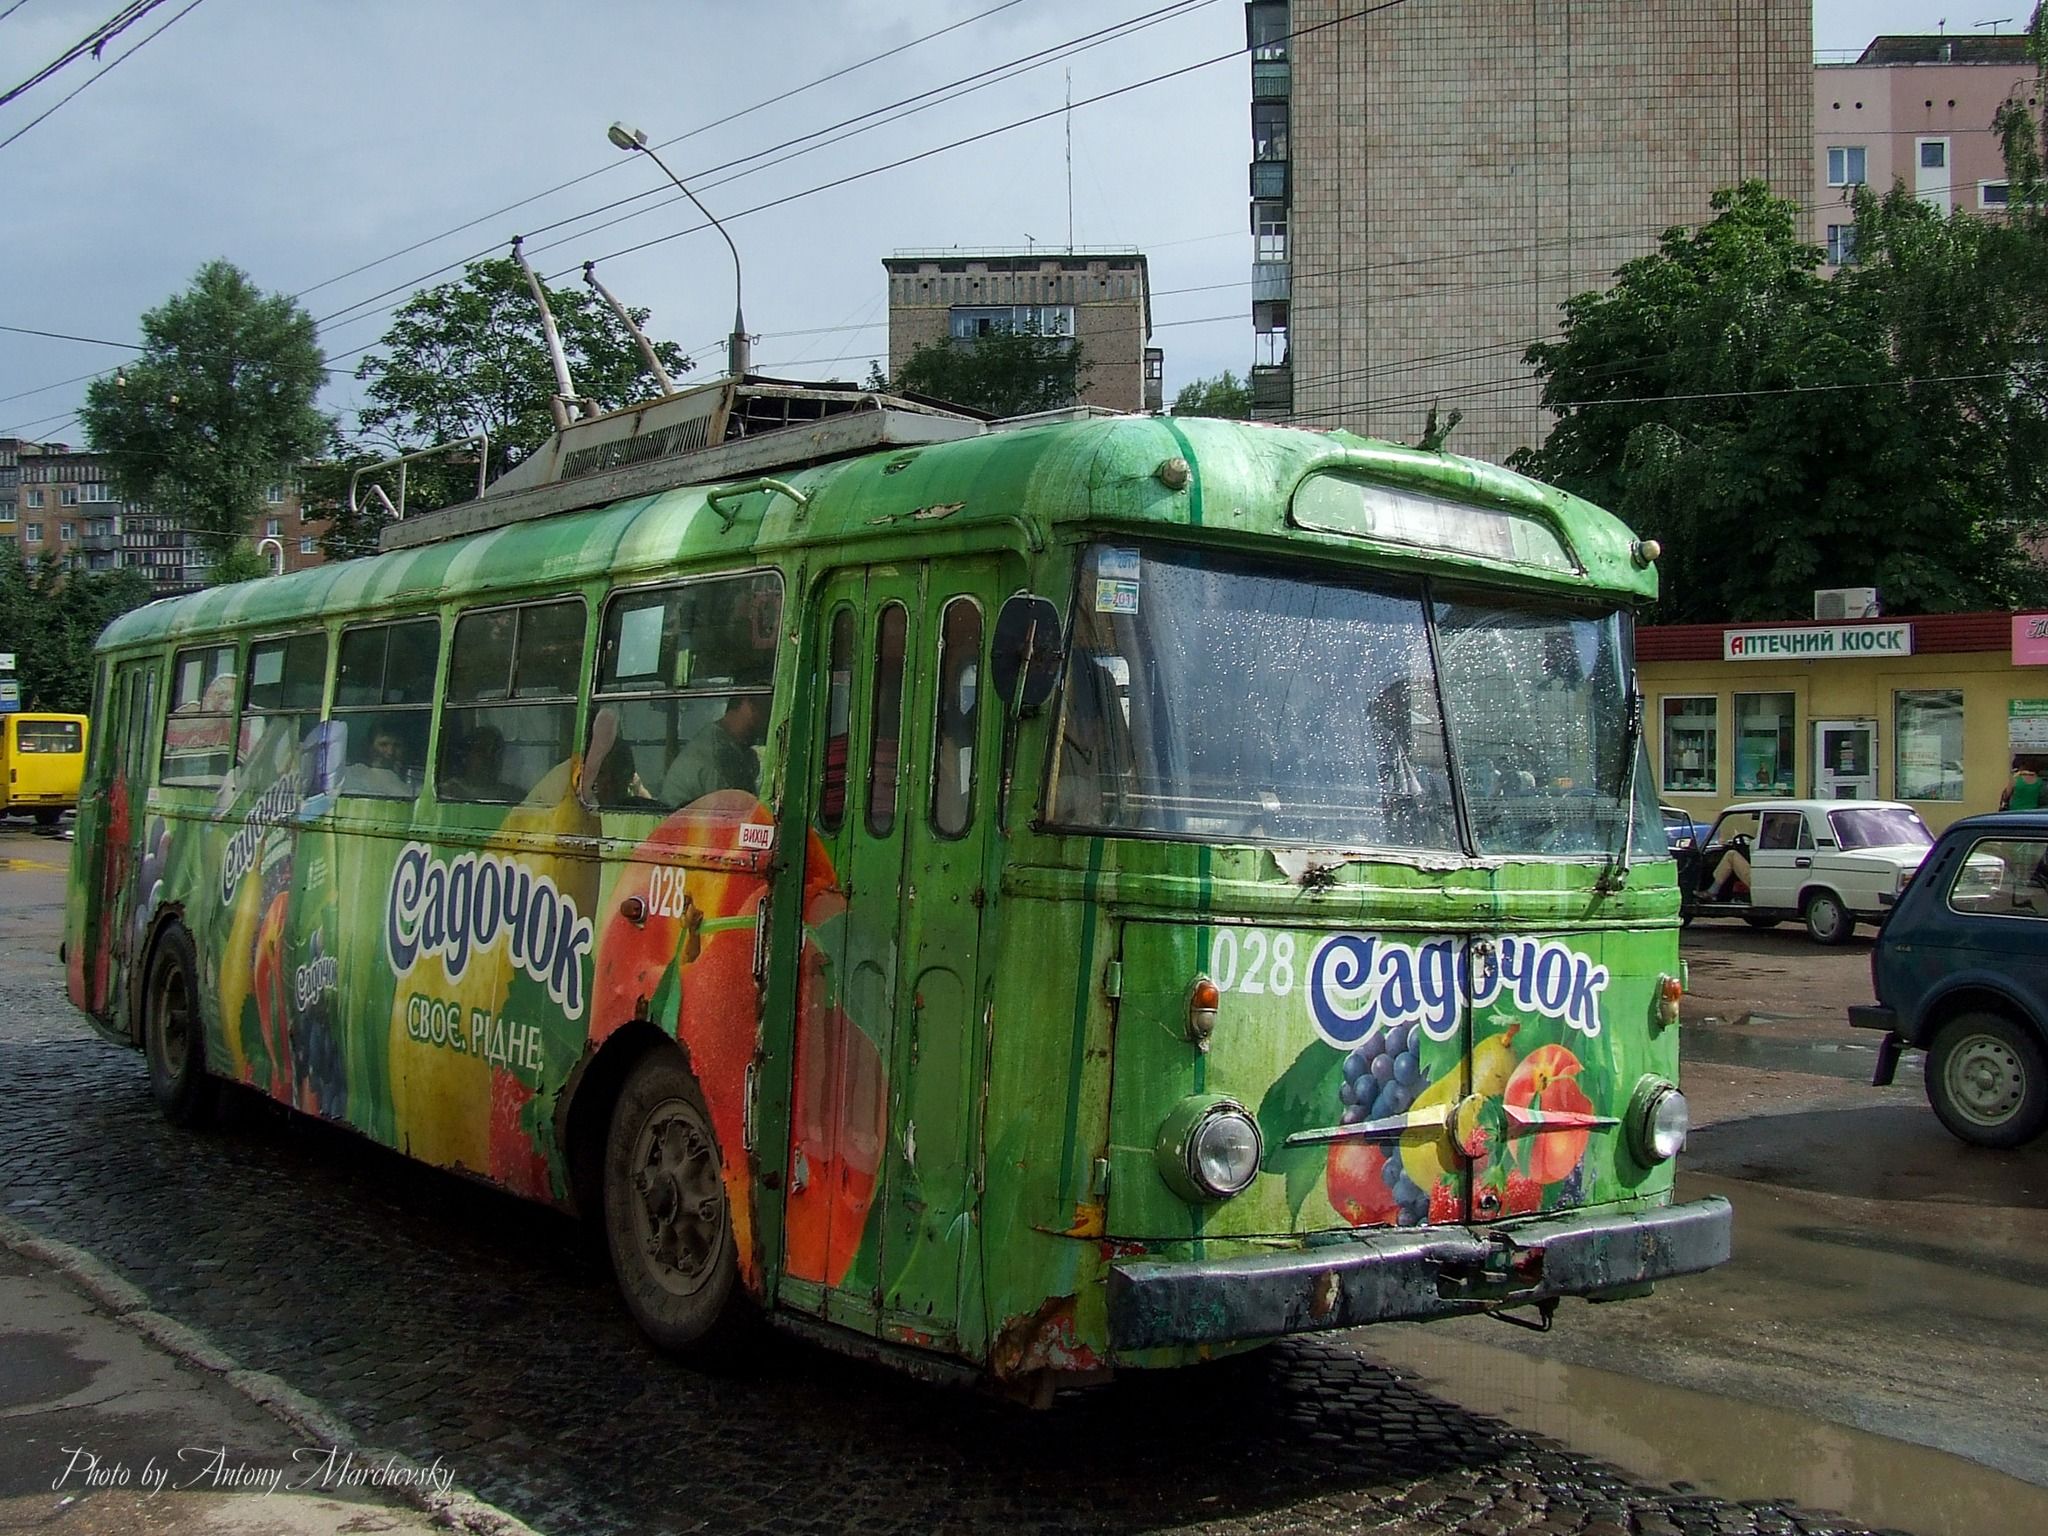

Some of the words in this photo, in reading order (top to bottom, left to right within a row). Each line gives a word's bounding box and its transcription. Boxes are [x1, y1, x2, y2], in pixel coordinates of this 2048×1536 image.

[1731, 630, 1834, 656] АПТЕЧНИЙ
[1841, 631, 1901, 651] КІОСК
[743, 828, 769, 848] ВИХІД
[649, 865, 686, 919] 028
[386, 842, 593, 1020] Садочок
[1212, 929, 1294, 996] 028
[1309, 932, 1609, 1049] Садочок
